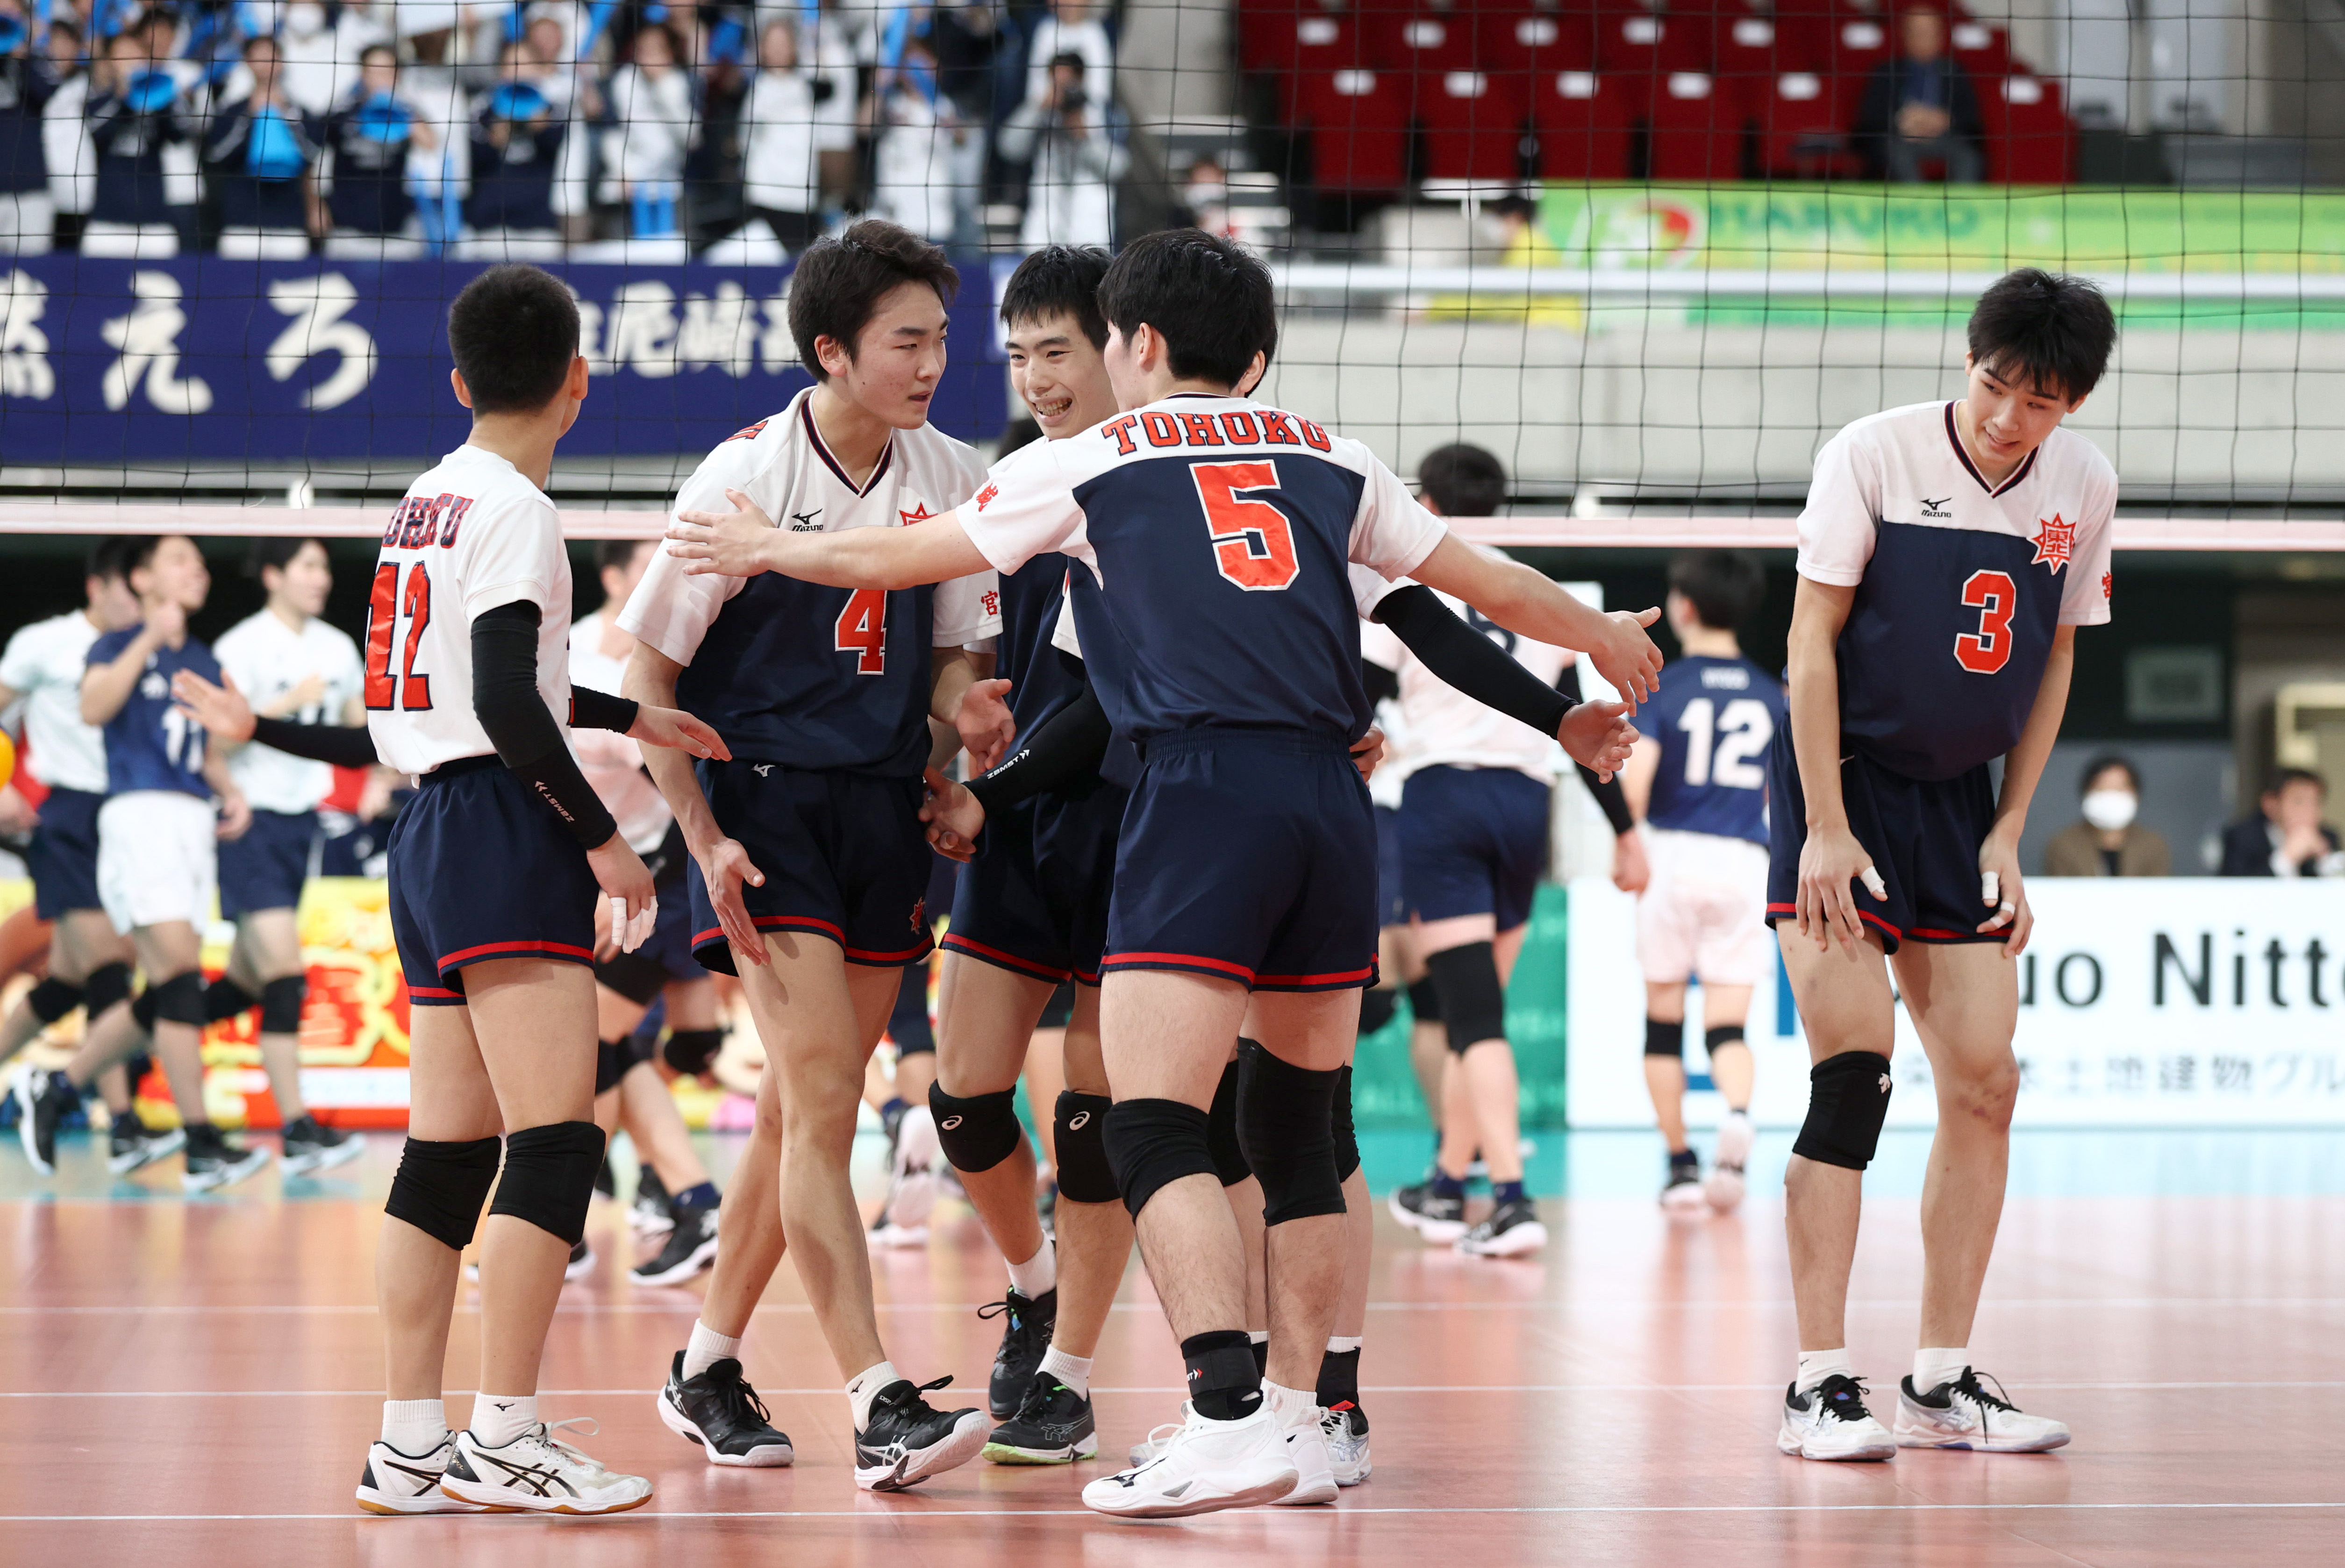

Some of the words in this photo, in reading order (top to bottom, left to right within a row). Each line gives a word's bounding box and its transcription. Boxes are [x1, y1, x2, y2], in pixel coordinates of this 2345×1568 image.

[1101, 410, 1332, 456] TOHOKU
[1188, 459, 1300, 592] 5
[364, 561, 433, 712] 12
[835, 589, 887, 675] 4
[1953, 569, 2016, 675] 3
[1677, 698, 1774, 790] 12
[2152, 929, 2345, 1008] Nitt
